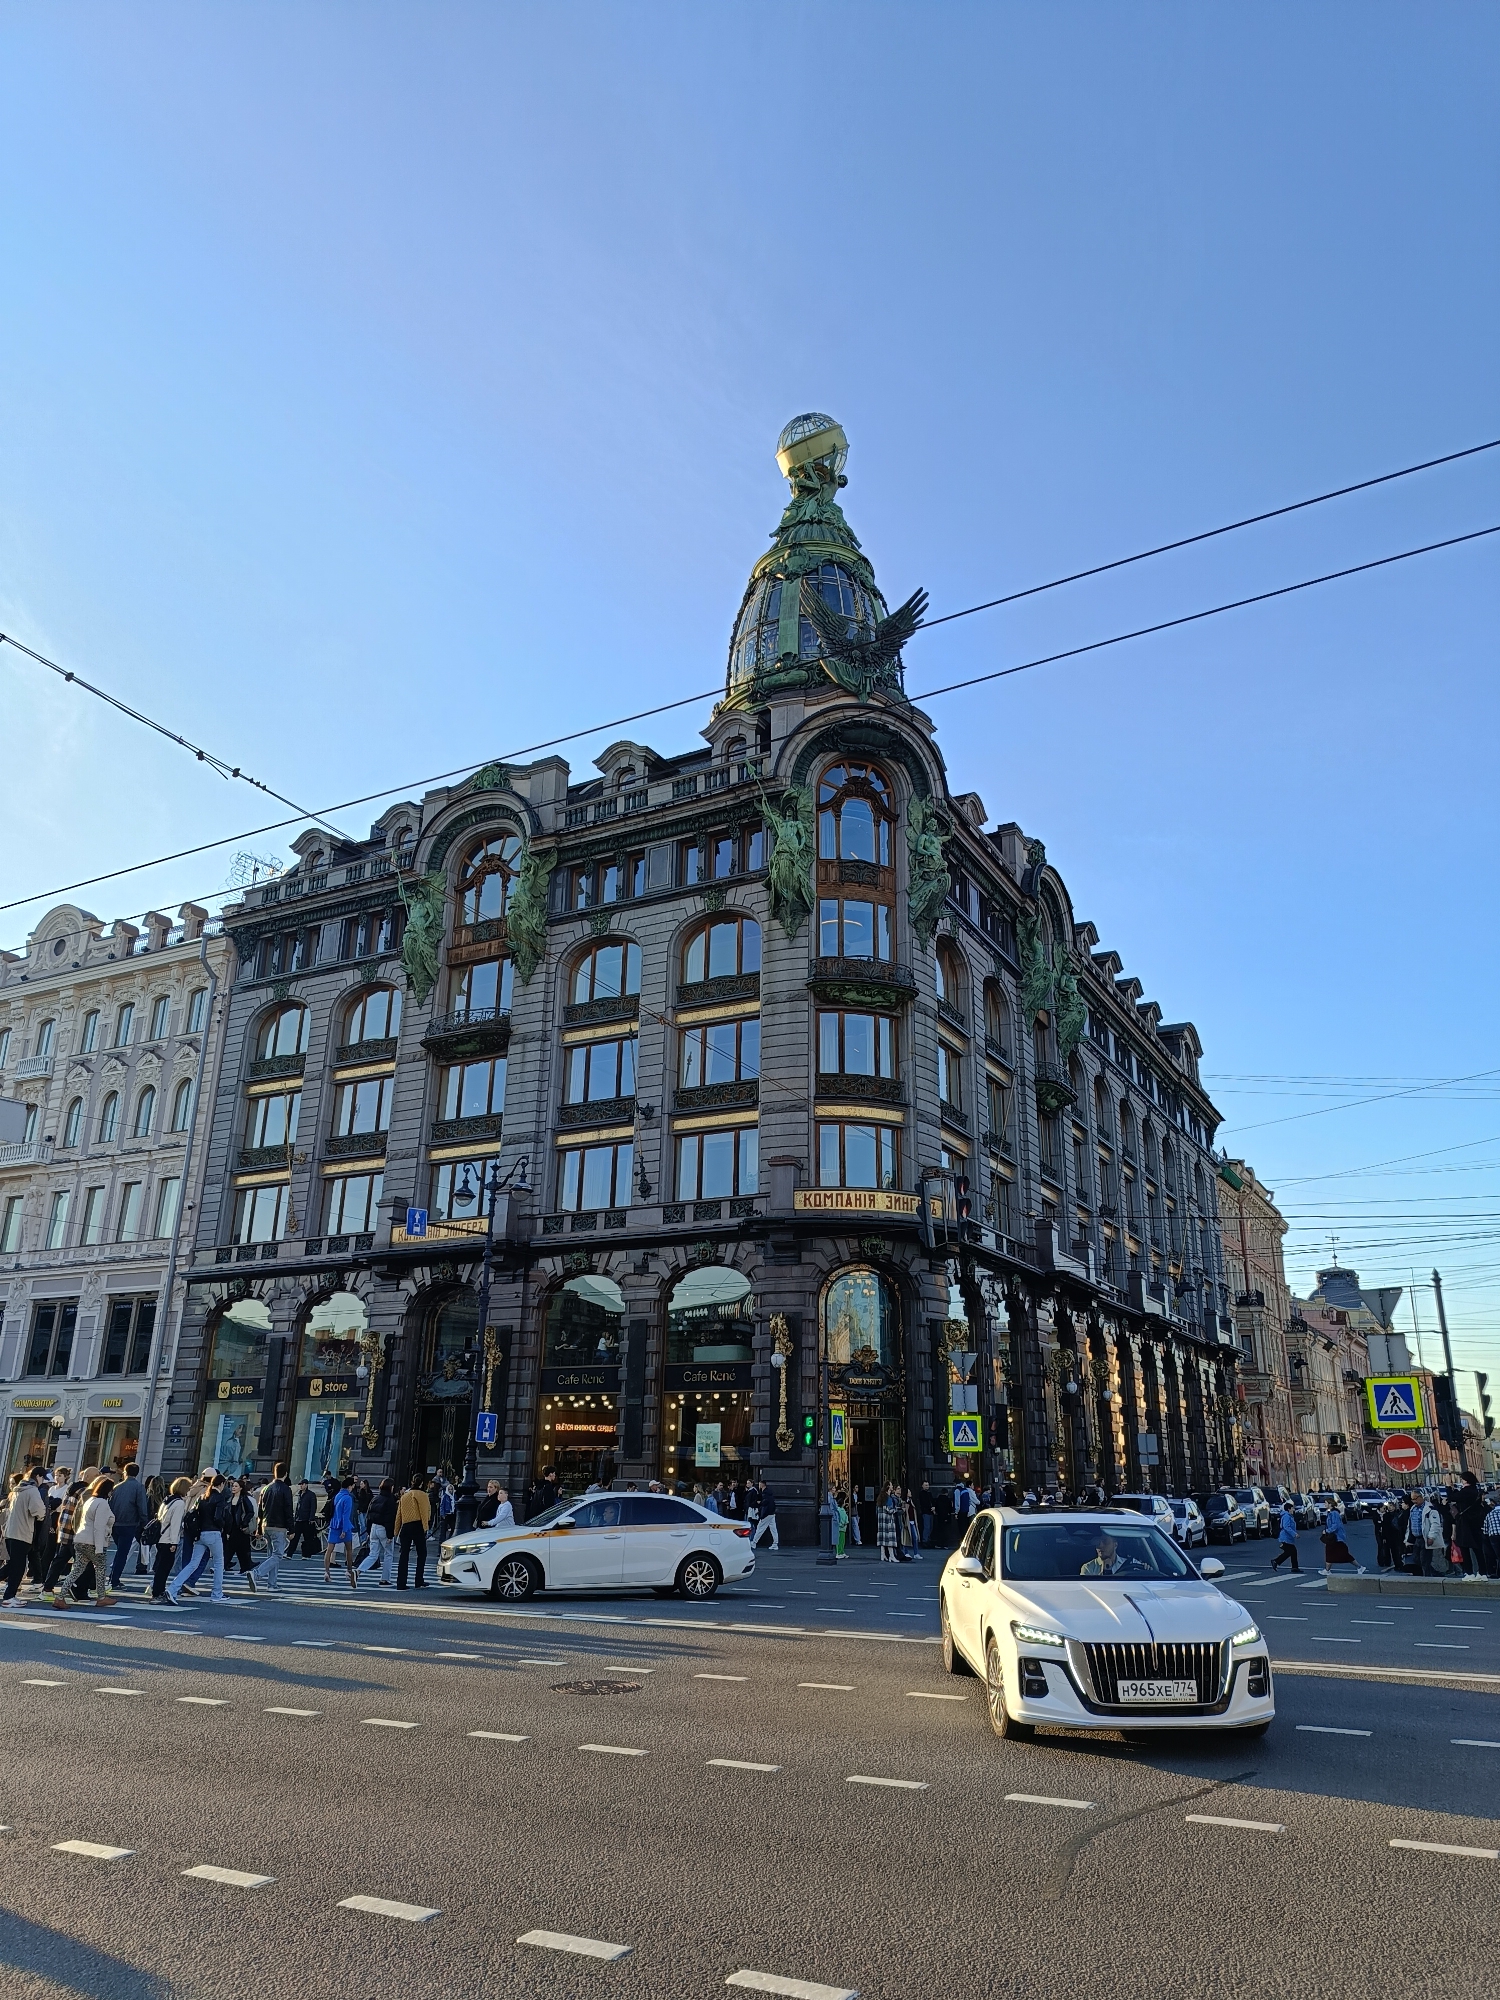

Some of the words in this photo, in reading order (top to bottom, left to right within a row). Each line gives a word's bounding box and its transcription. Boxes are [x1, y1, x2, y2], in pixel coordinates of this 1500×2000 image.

[803, 1192, 876, 1208] КОМПАНІЯ
[886, 1195, 937, 1216] ЗИНГЪ
[557, 1374, 579, 1385] Cafe
[581, 1371, 606, 1385] René
[683, 1370, 708, 1382] Cafe
[710, 1368, 737, 1382] René
[231, 1385, 254, 1395] store
[324, 1381, 348, 1392] store
[102, 1398, 122, 1408] НОТЫ
[1122, 1682, 1172, 1697] Н965ХЕ
[1174, 1681, 1195, 1693] 774
